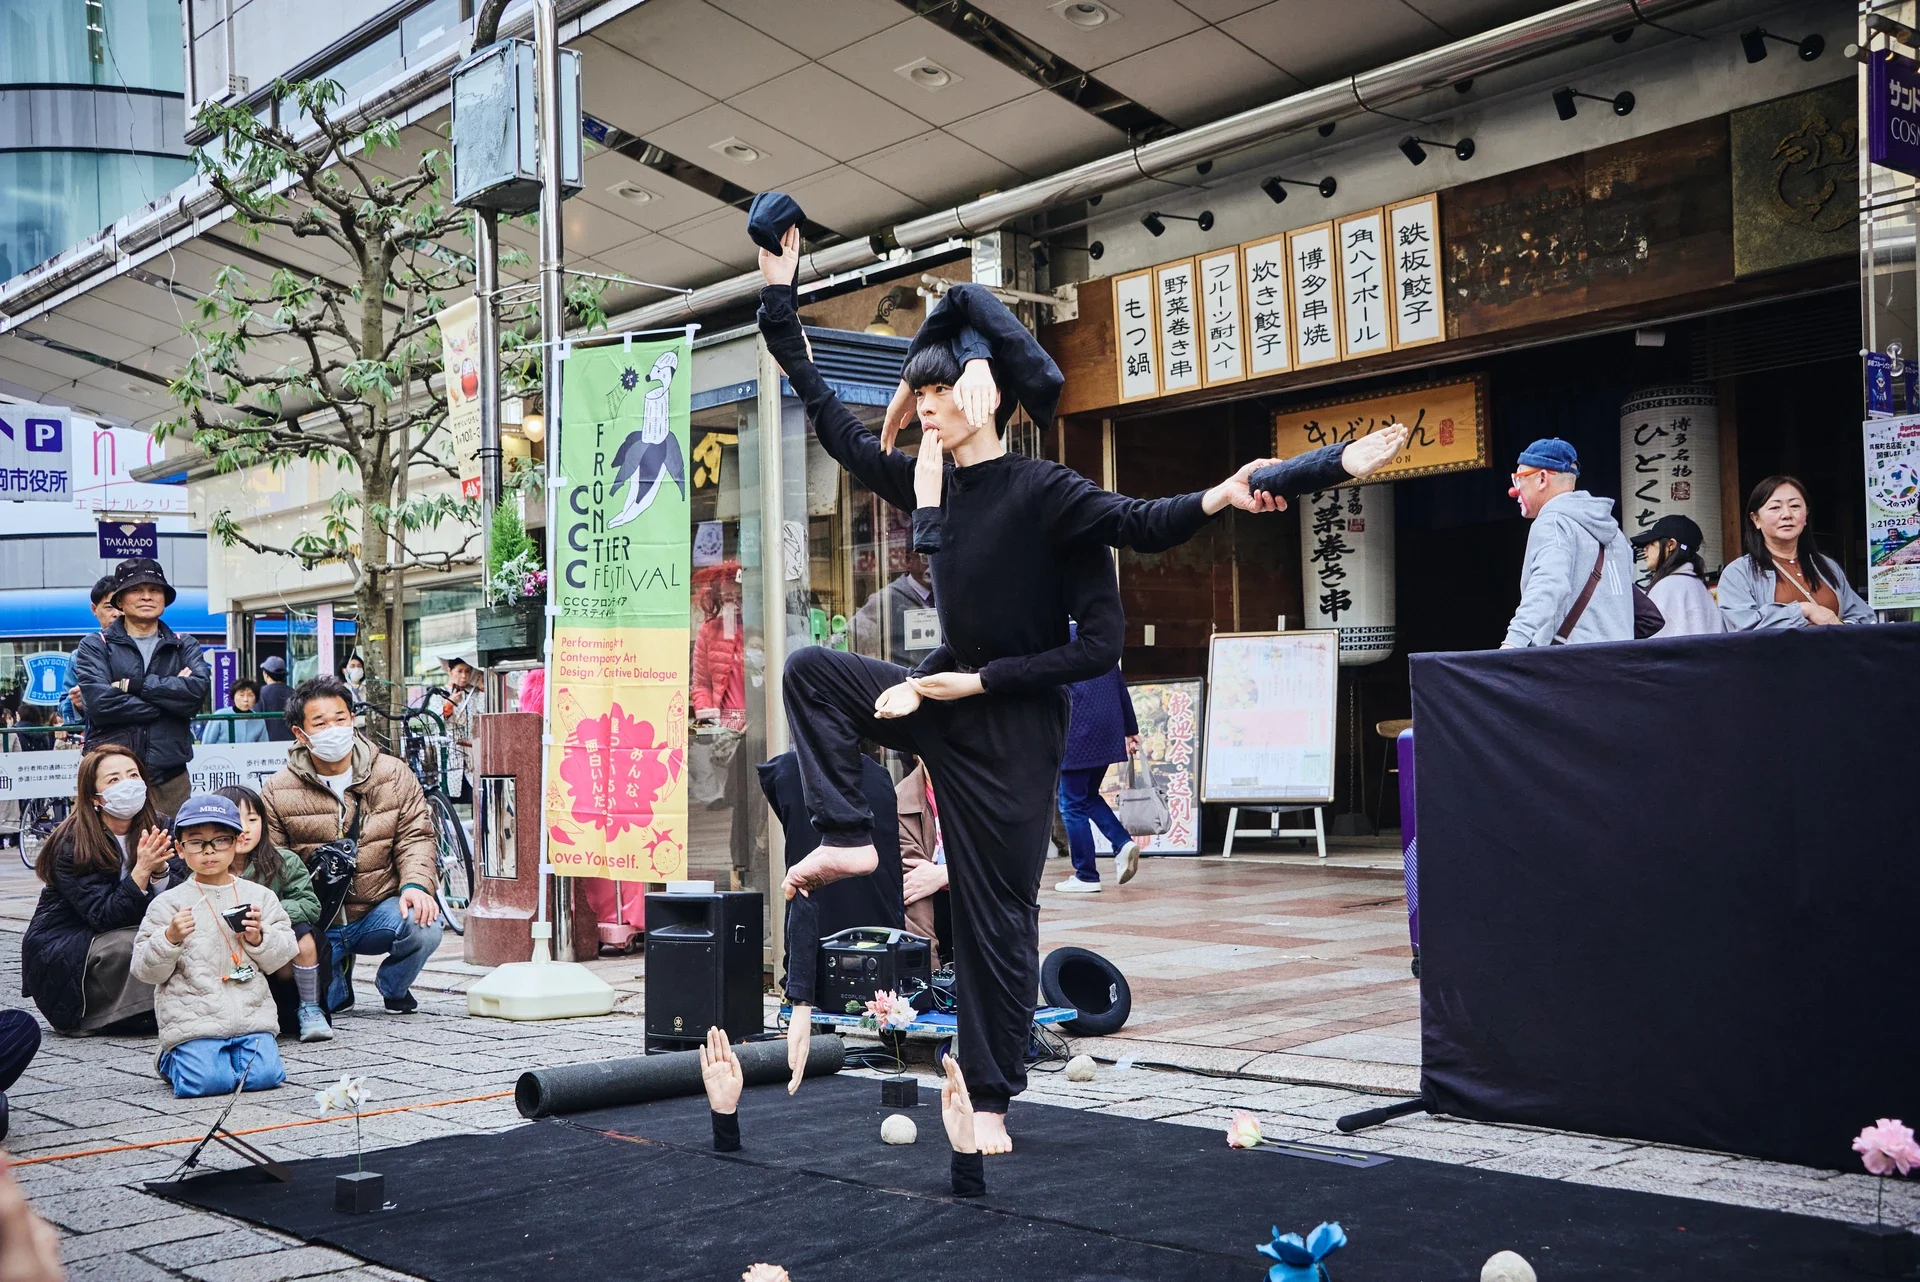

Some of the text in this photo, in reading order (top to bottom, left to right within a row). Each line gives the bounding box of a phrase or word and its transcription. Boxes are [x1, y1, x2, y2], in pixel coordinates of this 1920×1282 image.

[1298, 248, 1331, 346] 博多串焼
[1347, 229, 1381, 343] 角ハイボール
[1398, 222, 1434, 325] 鉄板餃子
[1125, 298, 1151, 377] もつ鍋
[1164, 275, 1193, 378] 野菜巻き串
[1209, 264, 1236, 369] フルーツ酎ハイ
[1252, 259, 1281, 355] 炊き餃子
[35, 424, 55, 447] P
[1670, 416, 1693, 478] 博多名物
[104, 537, 153, 547] TAKARADO
[593, 563, 680, 593] FESTIVAL
[31, 659, 69, 668] LAWSON
[560, 666, 594, 679] Design
[604, 667, 632, 678] Cretive
[633, 667, 678, 681] Dialogue
[622, 652, 637, 663] Art
[31, 692, 62, 700] STATIO
[192, 771, 241, 792] 呉服町
[585, 739, 607, 816] 面白いんだ。
[626, 747, 643, 808] みんな、
[1168, 692, 1193, 846] 歓迎会・送別会
[200, 805, 226, 814] MERCI
[555, 853, 583, 865] ove
